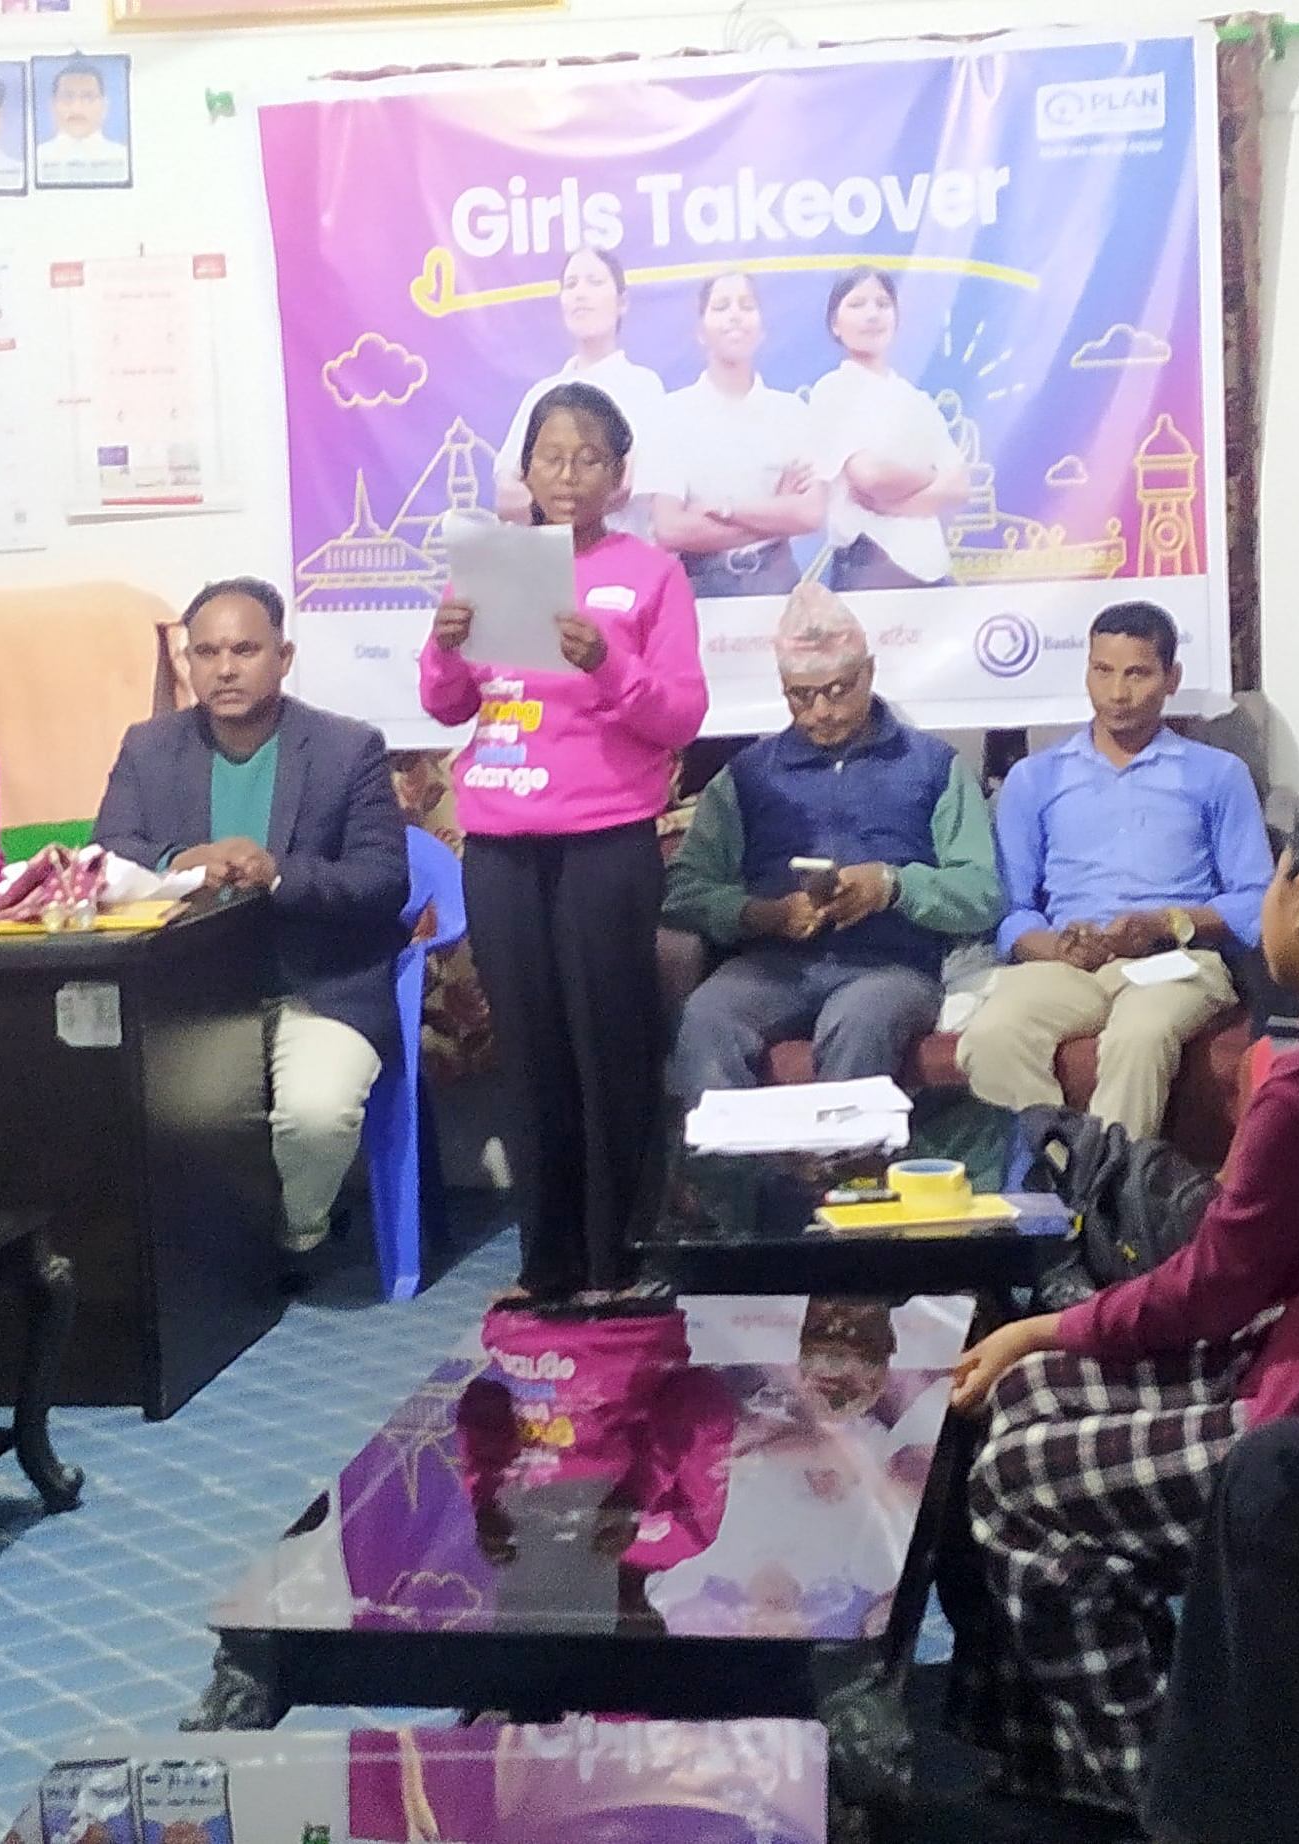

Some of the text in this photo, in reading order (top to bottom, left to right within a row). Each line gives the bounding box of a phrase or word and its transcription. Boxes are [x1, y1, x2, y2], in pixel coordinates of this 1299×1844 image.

[1091, 87, 1158, 111] PLAN
[451, 166, 1011, 258] Girls Takeover
[462, 763, 549, 796] change
